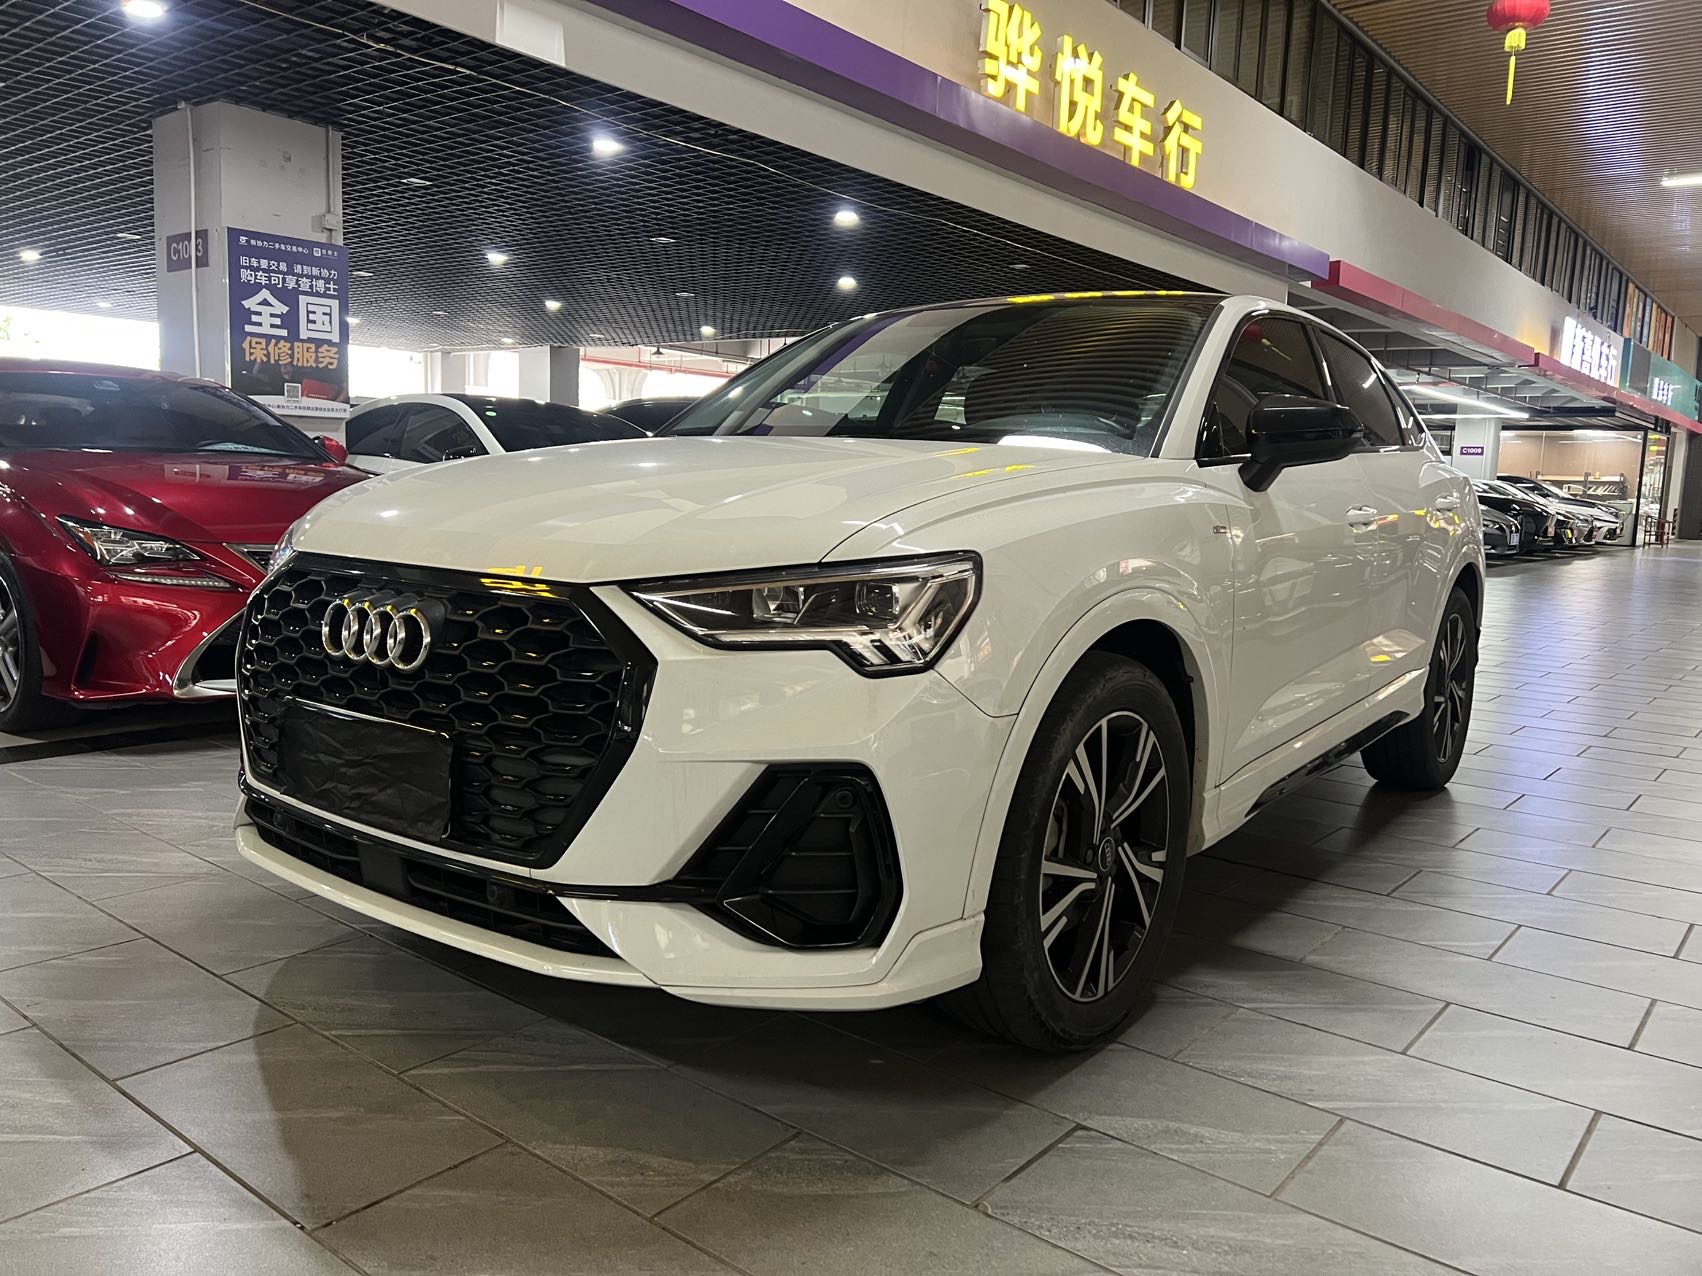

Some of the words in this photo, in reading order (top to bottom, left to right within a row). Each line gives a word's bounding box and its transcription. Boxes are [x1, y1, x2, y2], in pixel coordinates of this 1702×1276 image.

[980, 0, 1203, 189] 骅悦车行
[240, 256, 288, 272] 旧车要交易
[293, 263, 338, 279] 请到新协力
[240, 268, 339, 295] 购车可享查博士
[241, 288, 340, 343] 全国
[242, 336, 339, 369] 保修服务
